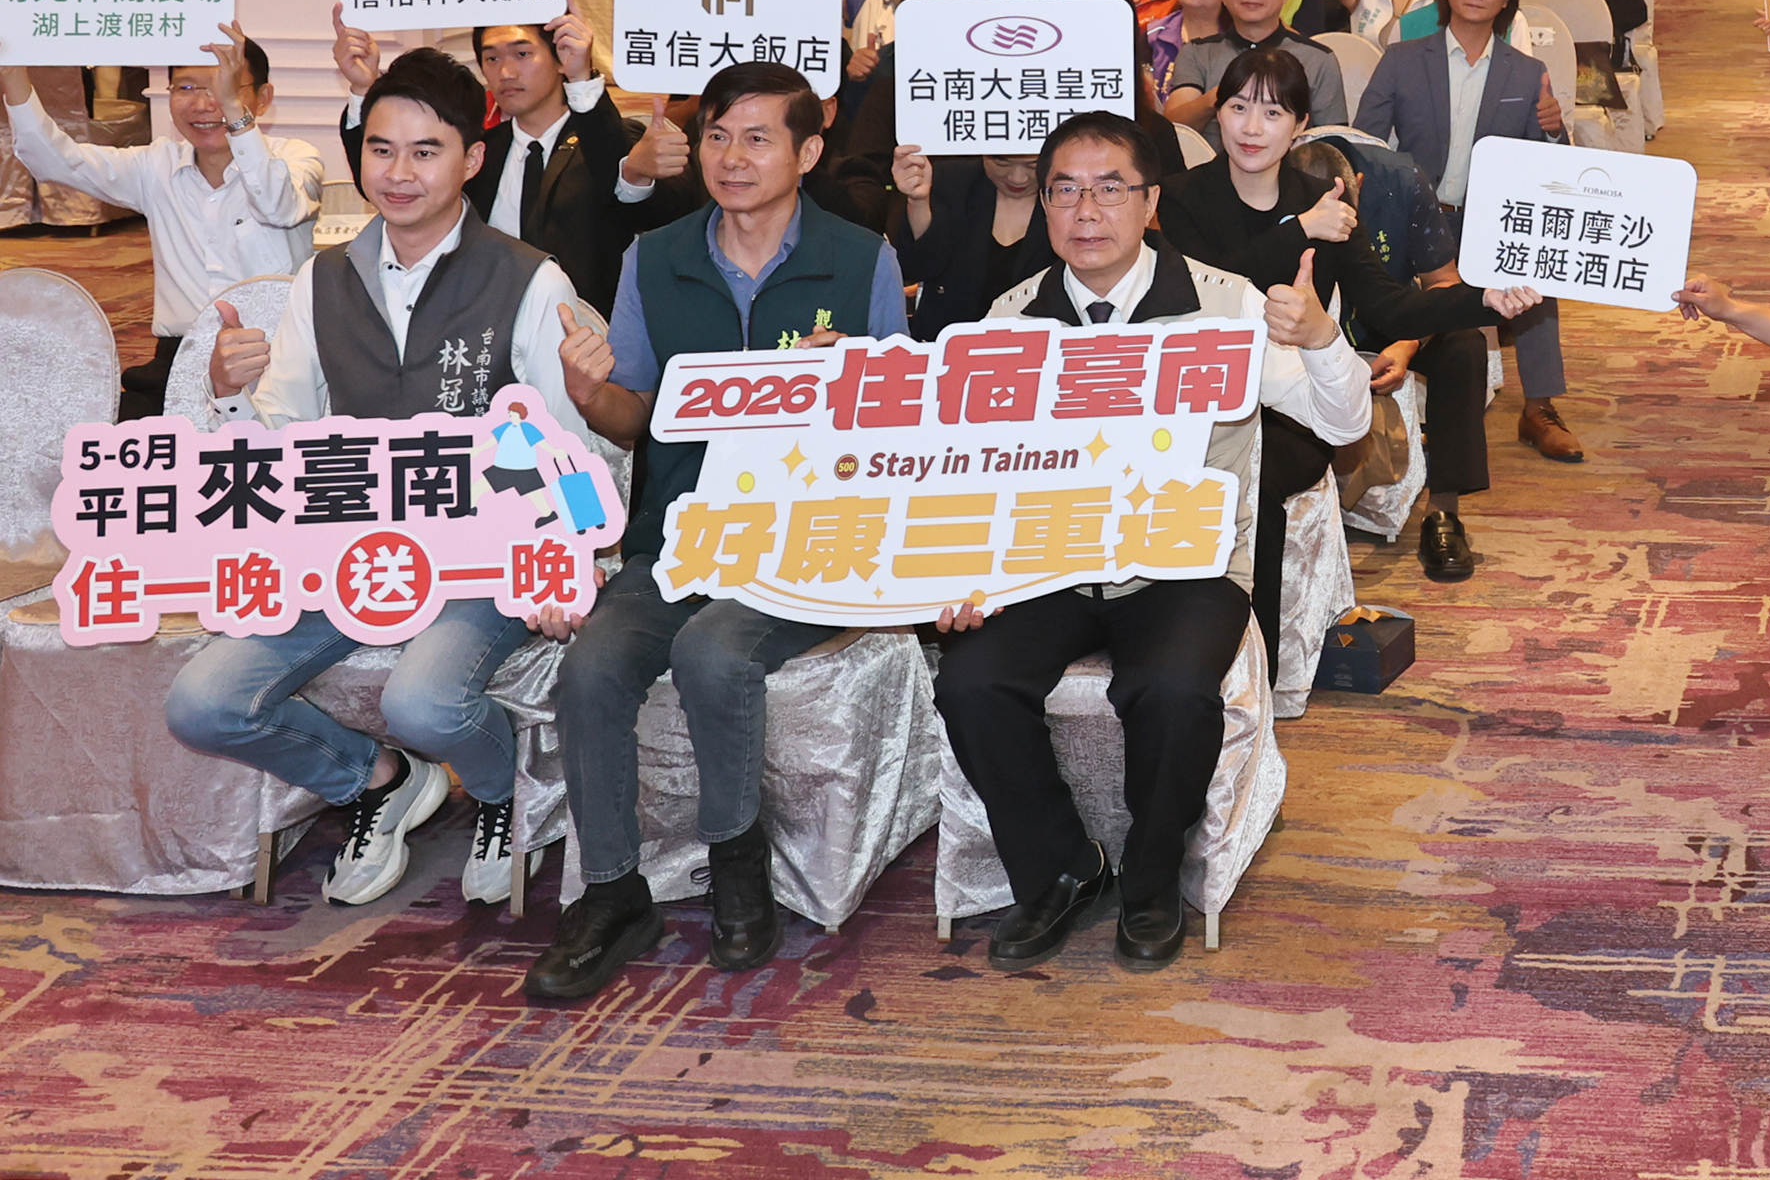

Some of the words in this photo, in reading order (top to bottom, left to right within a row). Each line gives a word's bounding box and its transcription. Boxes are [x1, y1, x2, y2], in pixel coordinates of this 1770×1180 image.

[32, 12, 186, 37] 湖上渡假村
[624, 28, 831, 73] 富信大飯店
[907, 67, 1124, 103] 台南大員皇冠
[1583, 186, 1623, 198] FORMOSA
[1500, 199, 1654, 249] 福爾摩沙
[1494, 240, 1649, 292] 遊艇酒店
[674, 373, 822, 419] 2026
[825, 328, 1255, 431] 住宿臺南
[79, 433, 178, 472] 5-6月
[837, 462, 855, 473] 500
[866, 452, 936, 482] Stay
[941, 446, 970, 474] in
[980, 443, 1080, 473] Tainan
[76, 484, 179, 537] 平日
[195, 430, 475, 530] 來臺南
[664, 476, 1227, 590] 好康三重送
